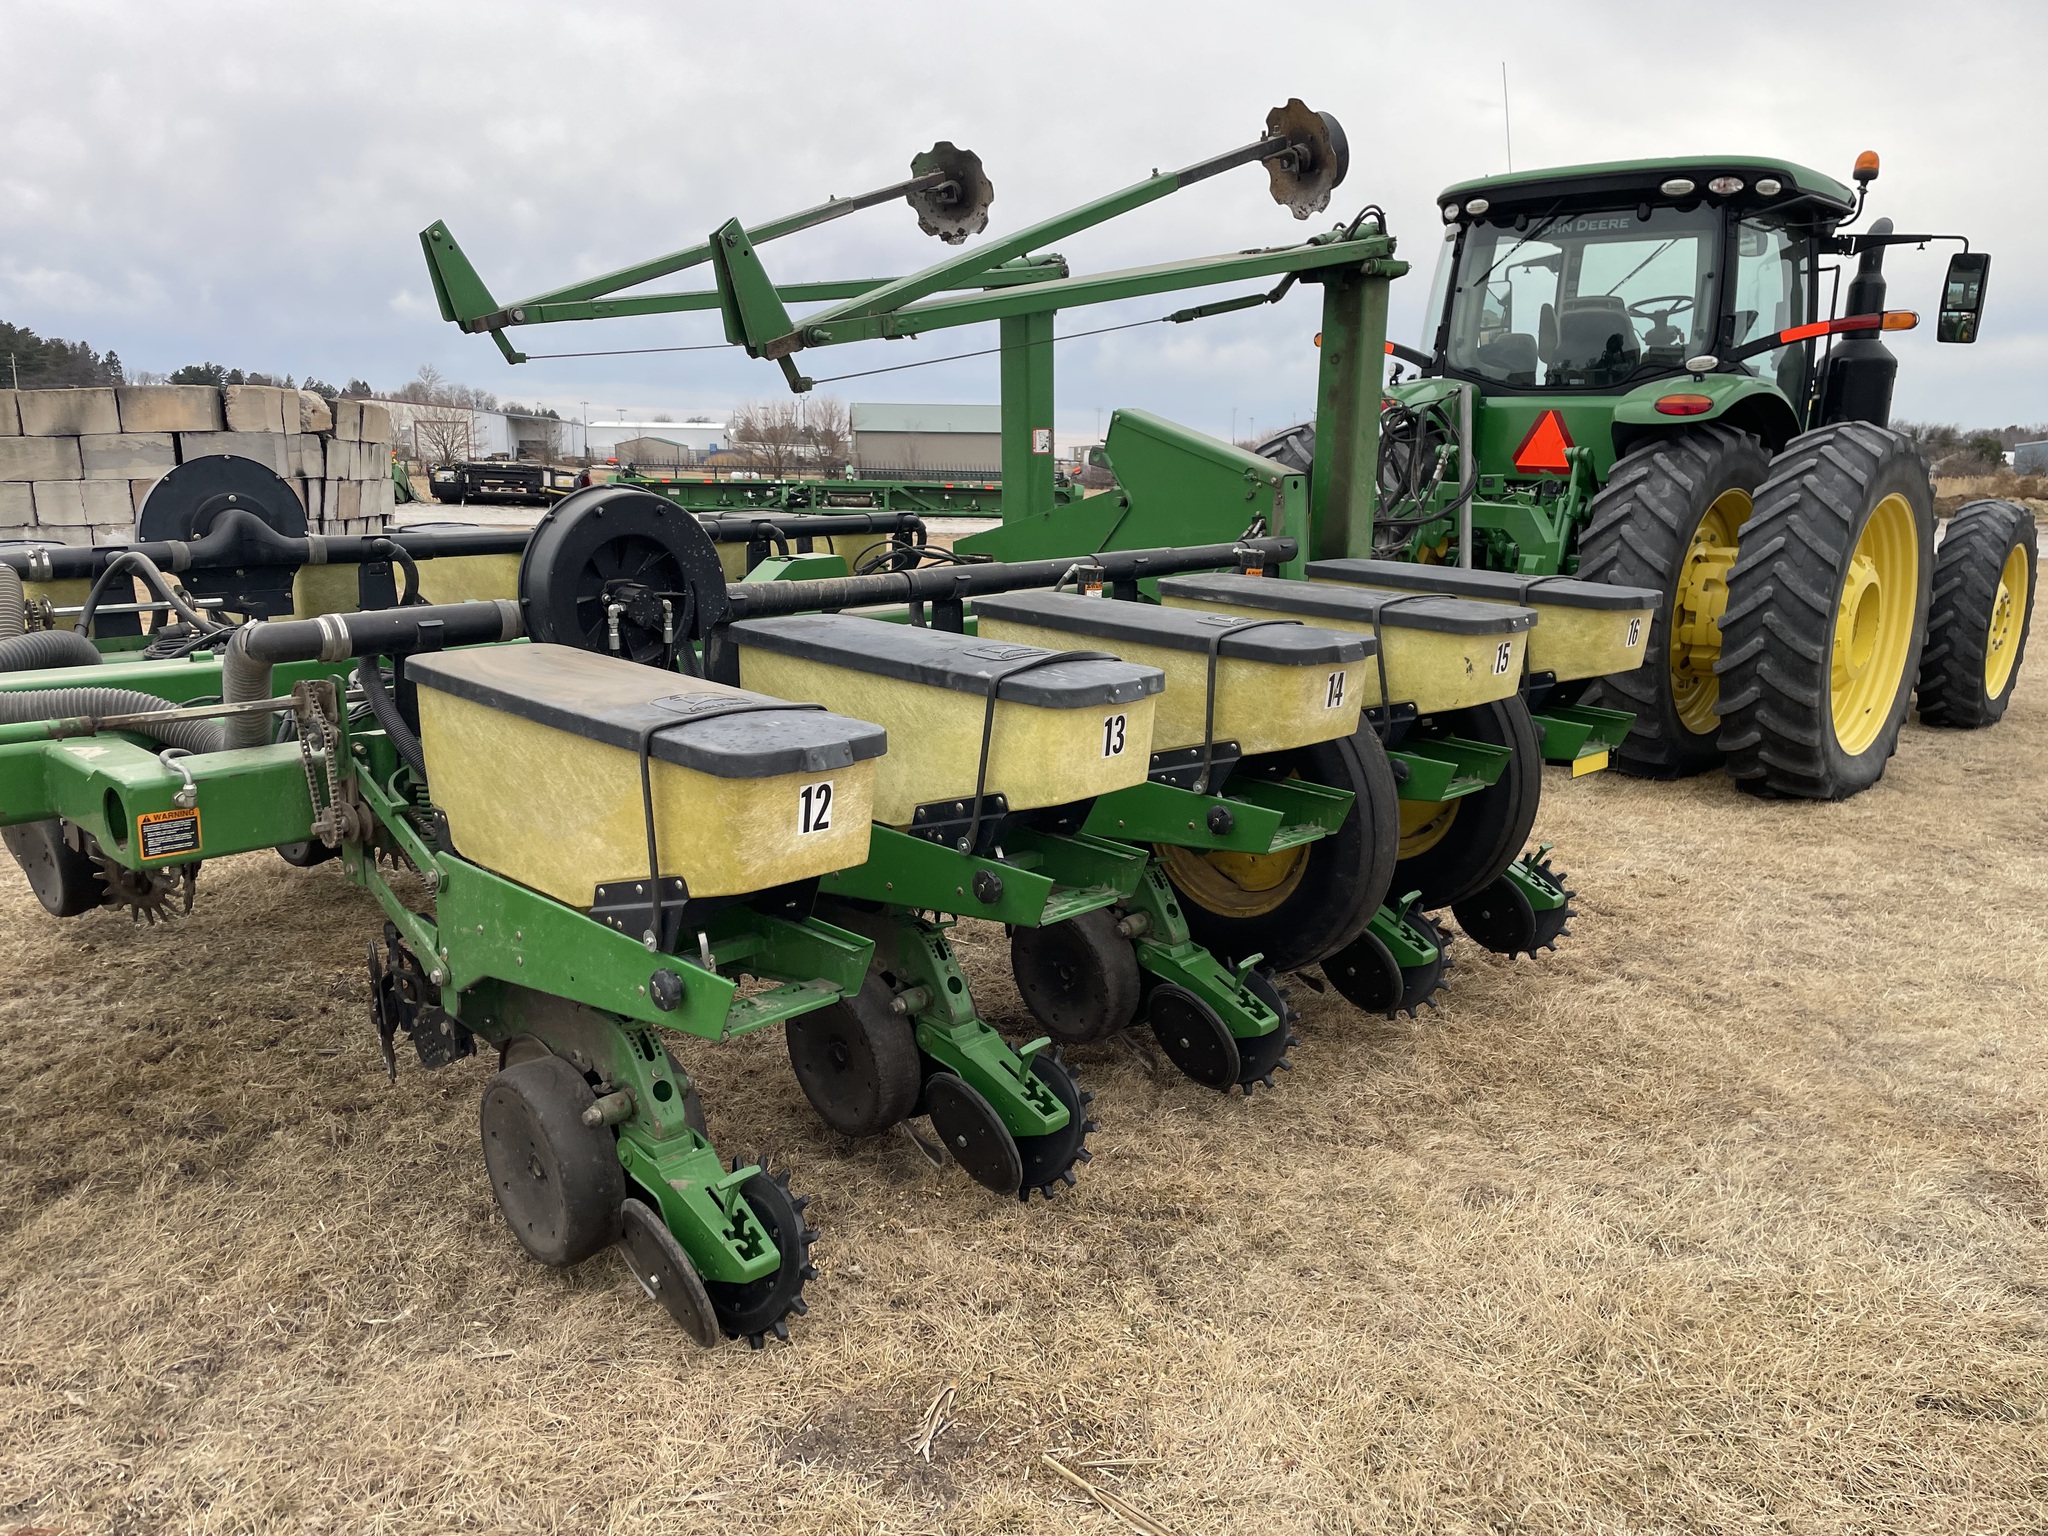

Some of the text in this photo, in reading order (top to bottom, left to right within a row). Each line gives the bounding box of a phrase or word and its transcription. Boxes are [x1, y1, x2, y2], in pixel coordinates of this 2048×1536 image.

[1576, 218, 1630, 232] DEERE
[1627, 618, 1640, 646] 16
[1496, 642, 1511, 673] 15
[1327, 672, 1344, 707] 14
[1104, 715, 1125, 756] 13
[153, 809, 195, 821] WARNING
[801, 784, 832, 833] 12
